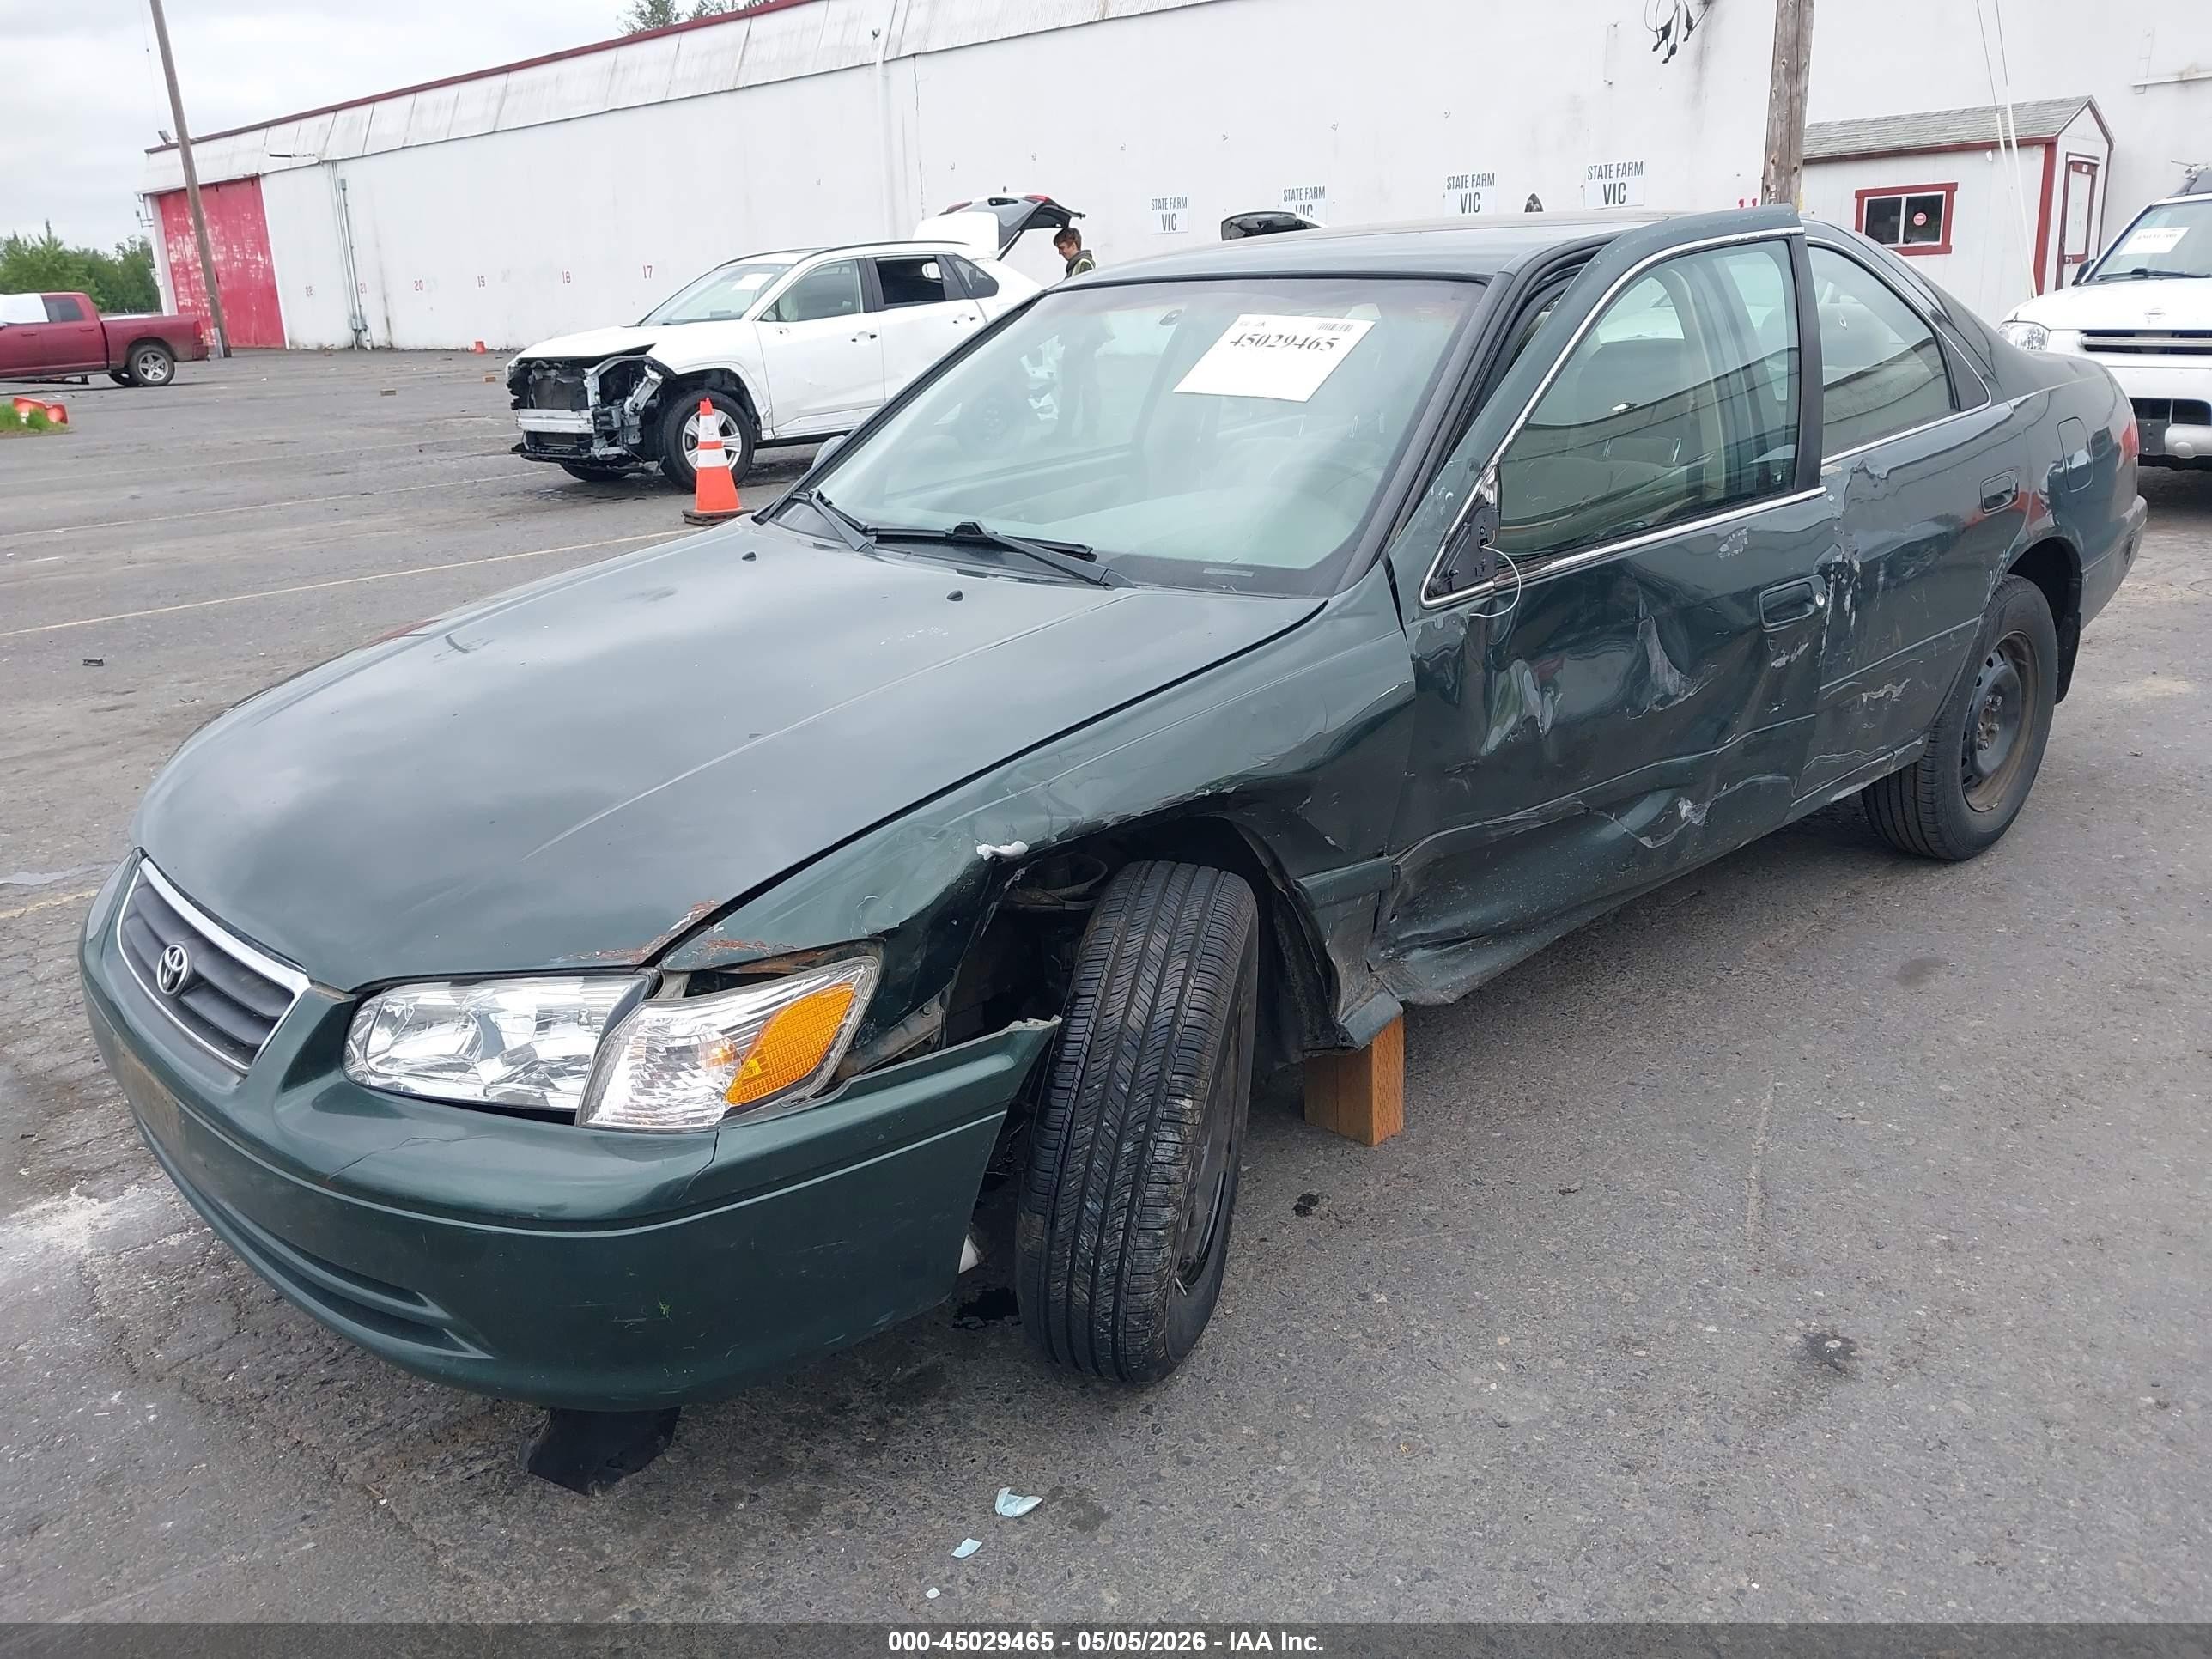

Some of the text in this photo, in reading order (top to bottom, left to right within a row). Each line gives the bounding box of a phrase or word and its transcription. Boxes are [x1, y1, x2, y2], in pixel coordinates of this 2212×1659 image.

[1587, 161, 1644, 180] STATE FARM
[1446, 173, 1495, 190] STATE FARM
[1283, 185, 1326, 203] STATE FARM
[1602, 182, 1626, 205] VIC
[1151, 196, 1188, 211] STATE FARM
[1460, 191, 1480, 214] VIC
[1161, 212, 1177, 232] VIC
[562, 270, 571, 284] 18
[642, 265, 653, 279] 17
[414, 279, 424, 291] 20
[477, 275, 486, 288] 19
[1230, 332, 1340, 351] 45029465
